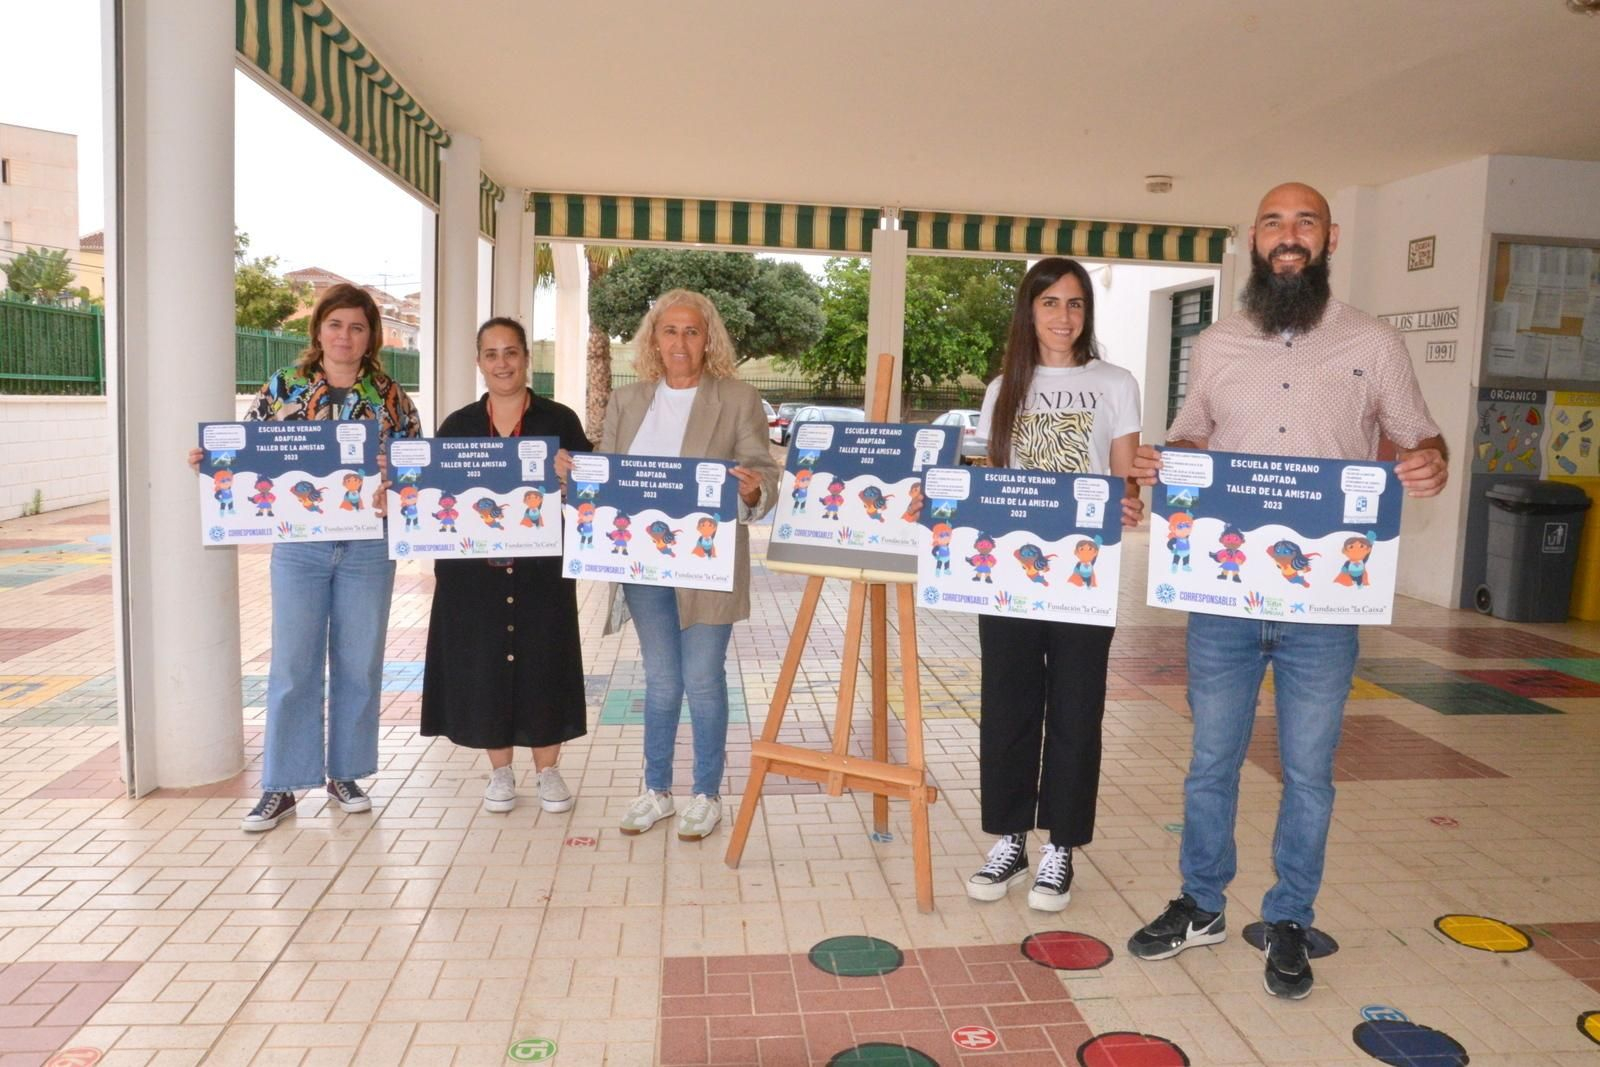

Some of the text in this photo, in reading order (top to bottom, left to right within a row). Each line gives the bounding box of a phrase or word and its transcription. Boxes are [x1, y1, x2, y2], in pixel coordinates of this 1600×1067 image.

[1395, 312, 1457, 329] LOS LLANOS
[1429, 344, 1452, 360] 1991
[1022, 391, 1103, 410] UNDAY
[1490, 390, 1537, 400] ORGANICO
[1231, 459, 1319, 473] ESCUELA DE VERANO
[985, 474, 1015, 483] ESCUELA
[1028, 476, 1056, 484] VERANO
[1252, 474, 1296, 485] ADAPTADA
[1002, 487, 1038, 495] ADAPTADA
[1226, 484, 1321, 500] TALLER DE LA AMISTAD
[981, 496, 1059, 508] TALLER DE LA AMISTAD
[1263, 500, 1282, 510] 2023
[1180, 591, 1237, 607] CORRESPONSABLES
[1309, 604, 1349, 613] Fundación
[957, 1030, 992, 1046] 14
[515, 1041, 548, 1059] 15
